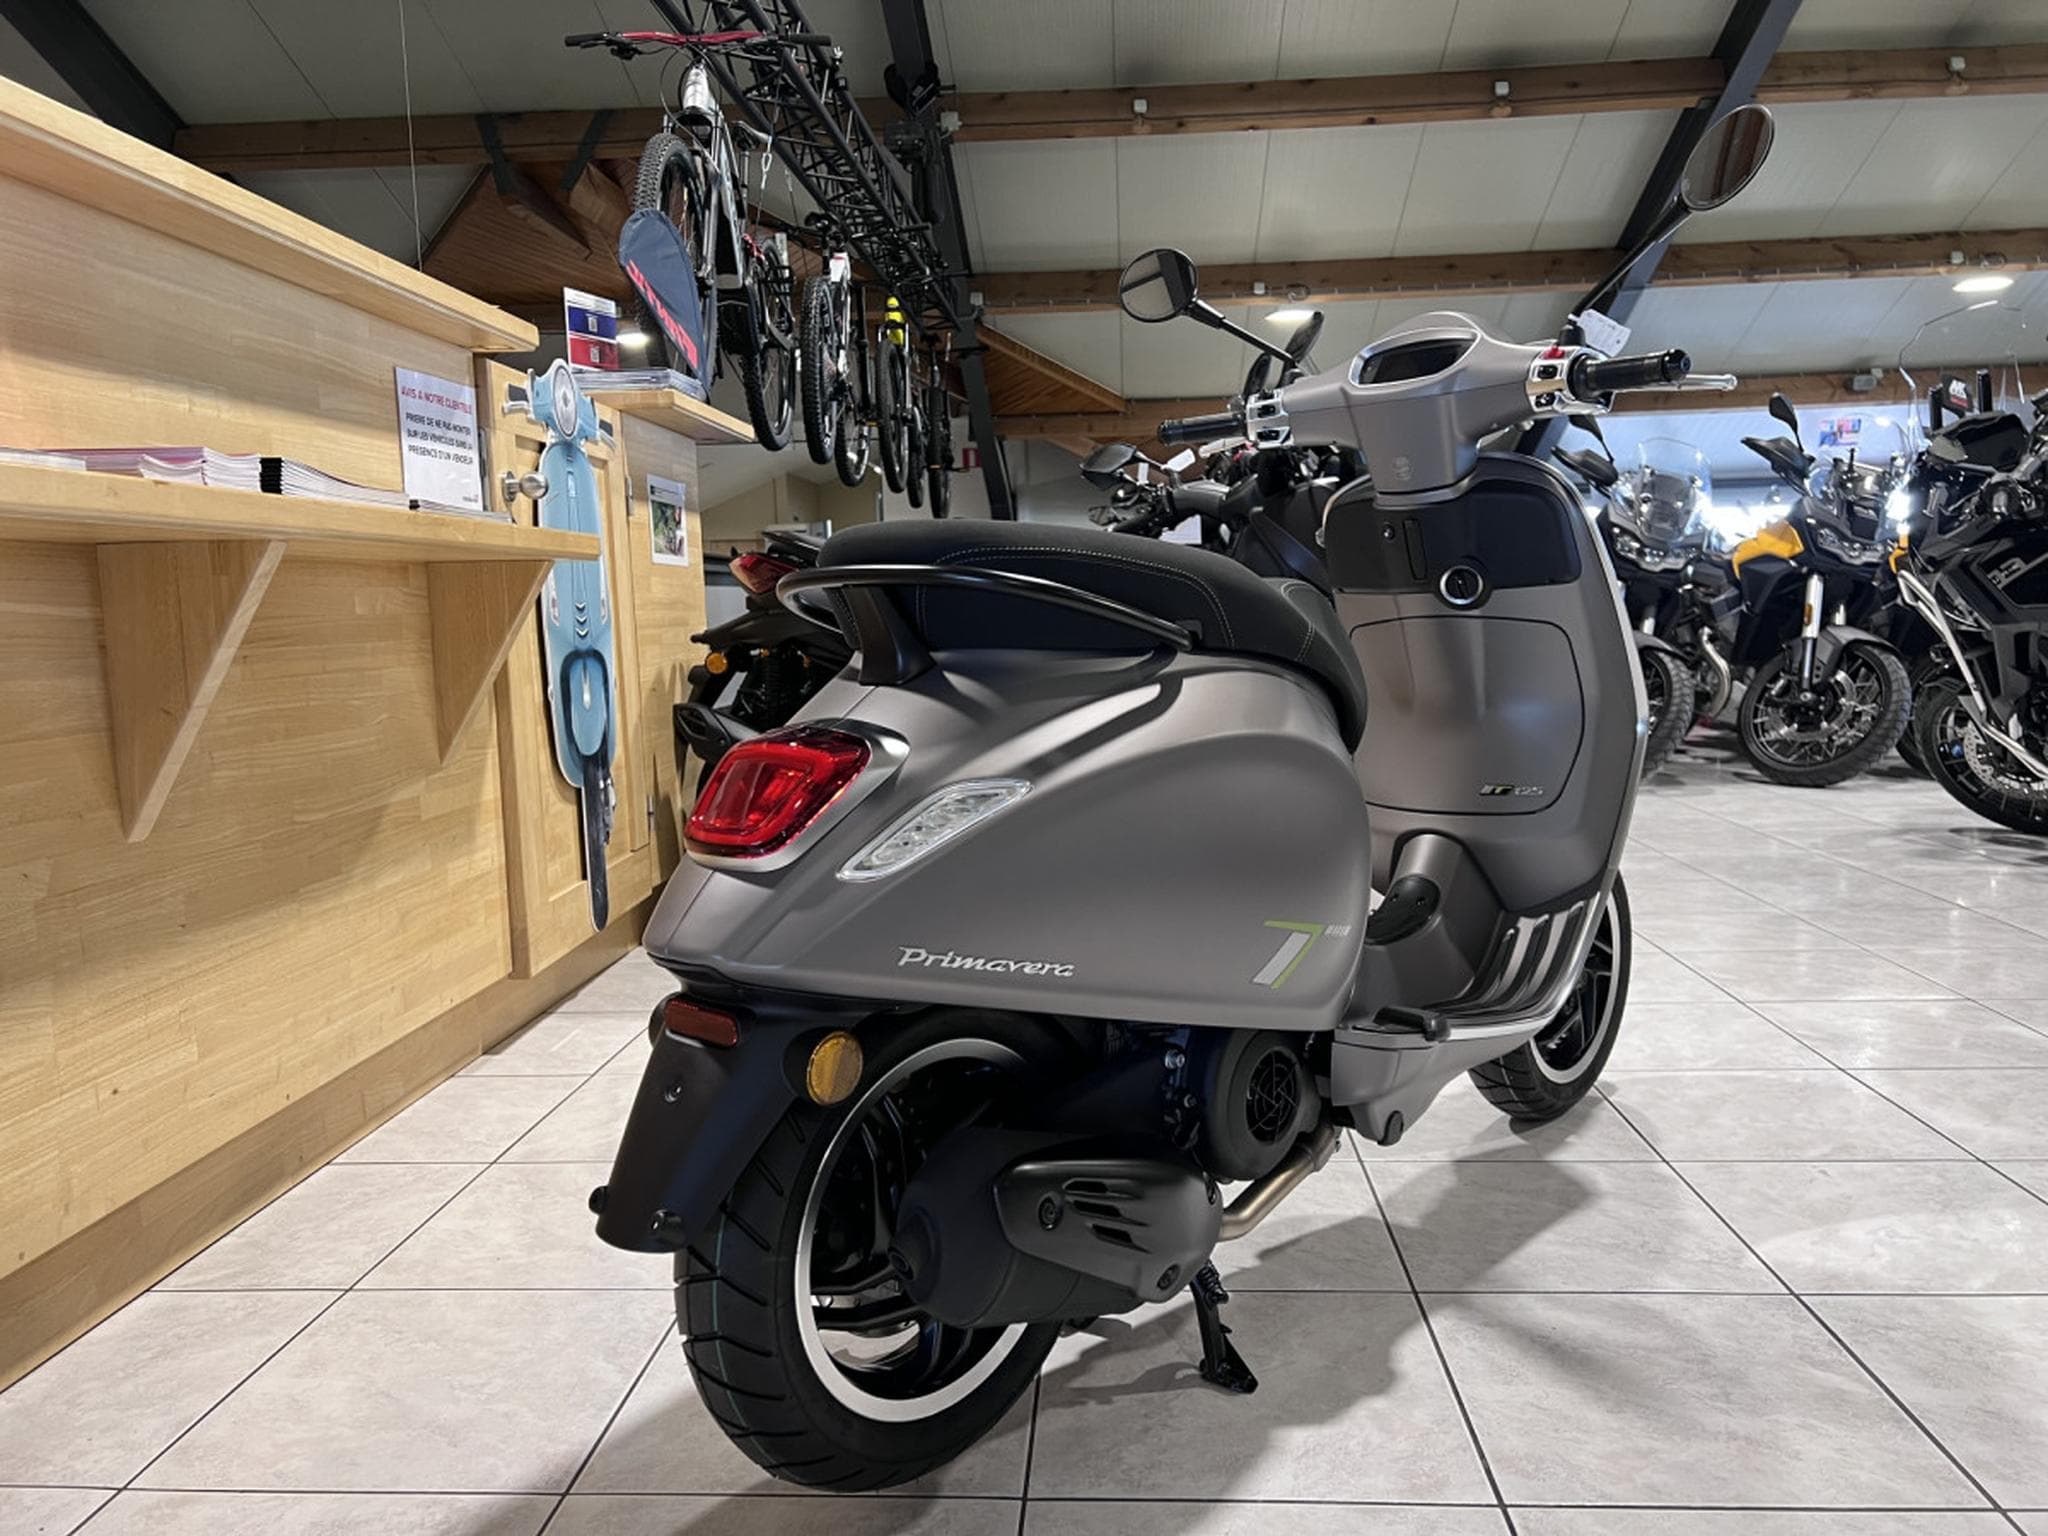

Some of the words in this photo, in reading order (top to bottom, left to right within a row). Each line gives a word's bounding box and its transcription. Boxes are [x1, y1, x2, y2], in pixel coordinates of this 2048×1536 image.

[407, 428, 418, 438] SUR
[426, 416, 434, 427] DE
[435, 419, 442, 428] NE
[442, 421, 452, 431] PAS
[453, 424, 471, 436] MONTER
[898, 945, 1075, 978] Primavera
